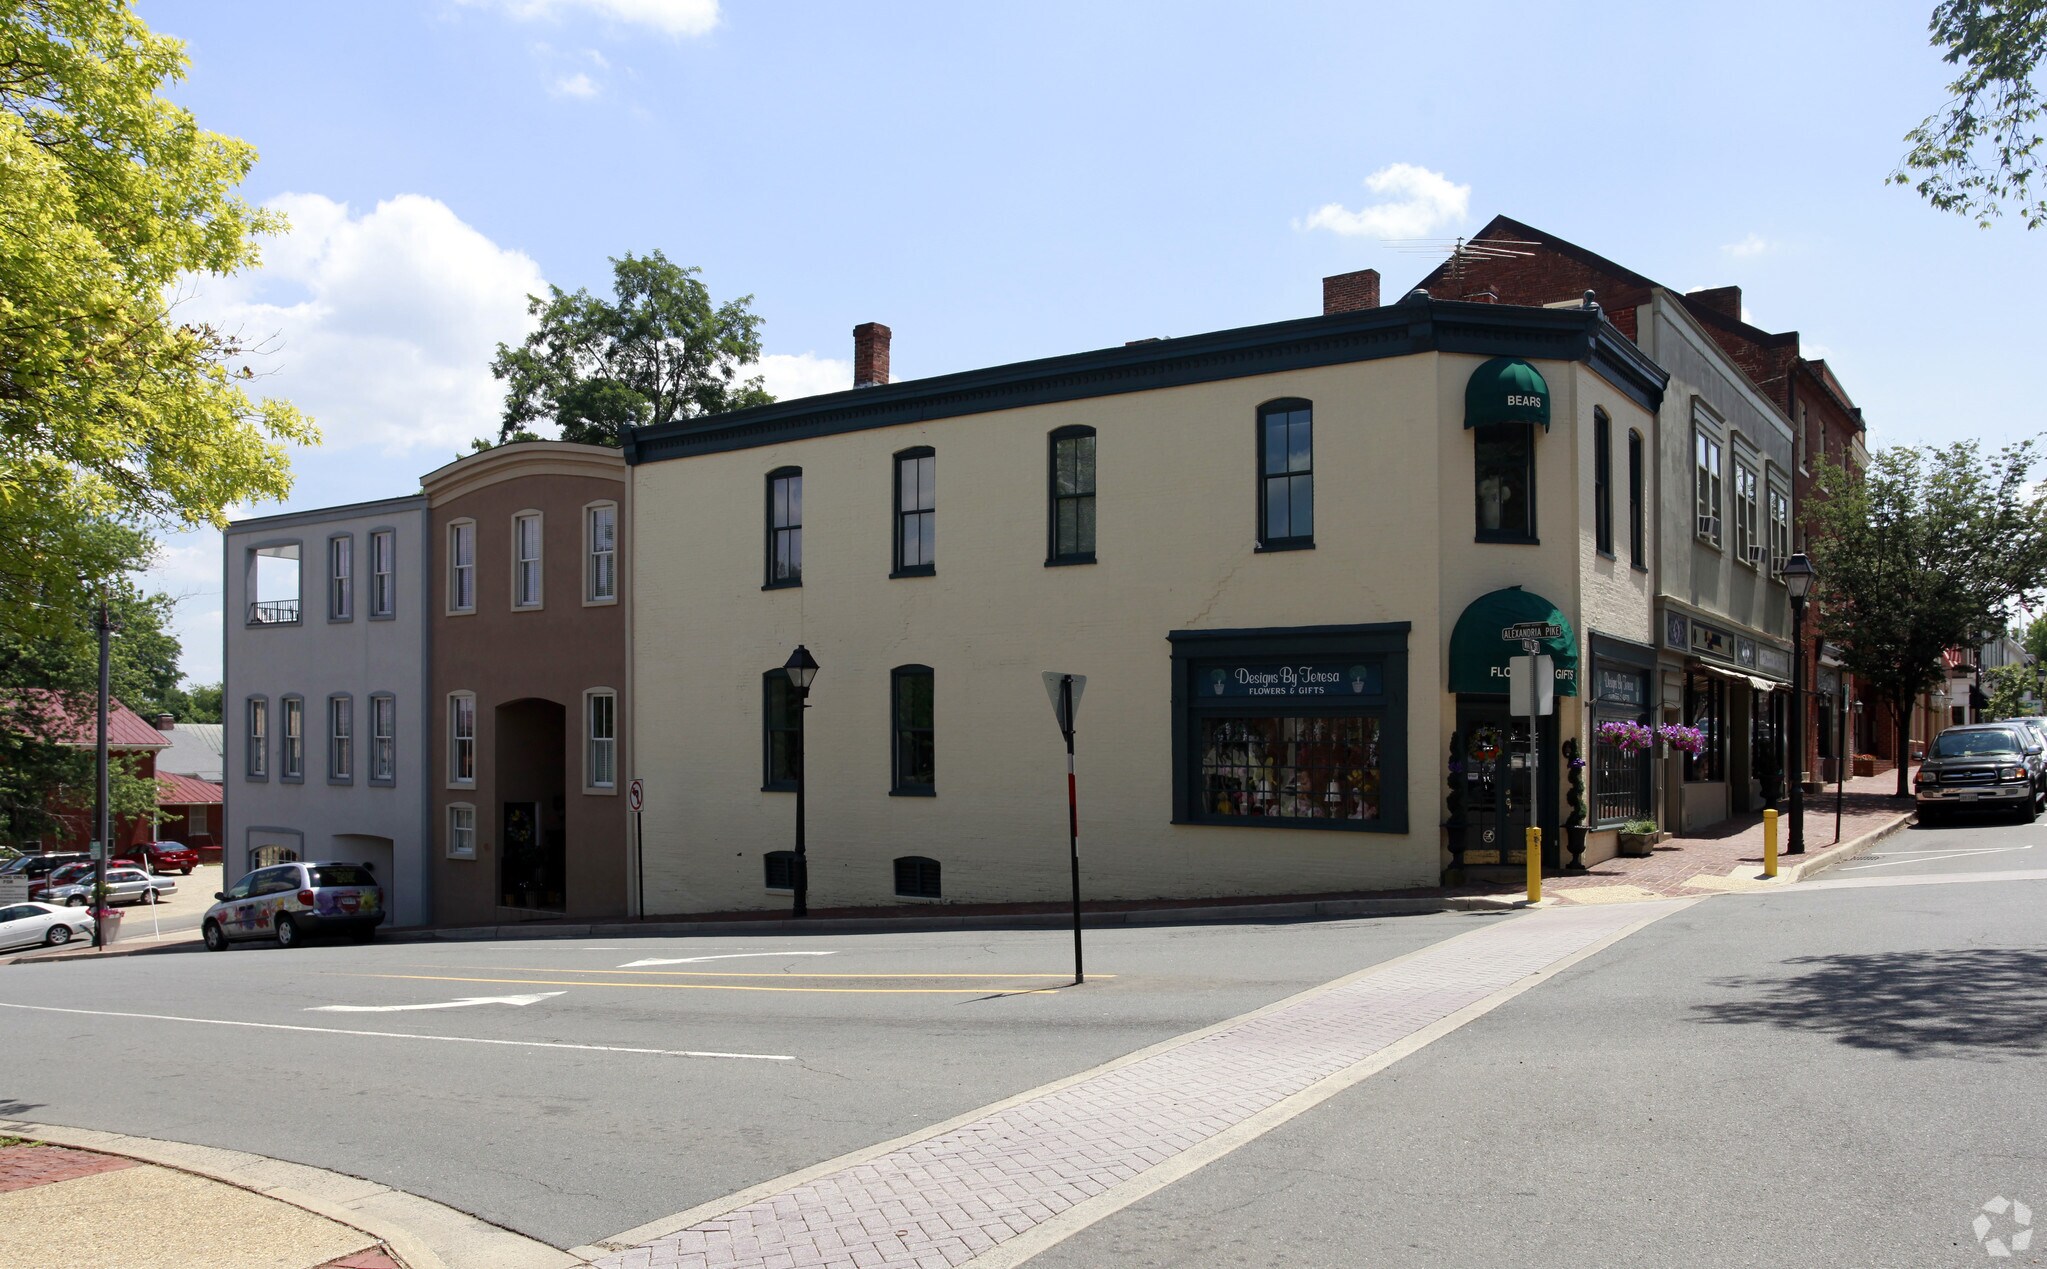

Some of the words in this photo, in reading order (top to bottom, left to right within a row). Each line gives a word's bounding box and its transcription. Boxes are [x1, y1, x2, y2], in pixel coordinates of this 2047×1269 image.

[1507, 395, 1541, 408] BEARS
[1504, 627, 1542, 639] ALEXANDRIA
[1545, 626, 1559, 636] PIKE
[1234, 667, 1278, 687] Designs
[1279, 666, 1298, 688] By
[1298, 666, 1340, 684] Teresa
[1555, 669, 1574, 680] GIFTS
[1249, 687, 1286, 695] FLOWERS
[1289, 687, 1295, 695] &
[1298, 686, 1325, 695] GIFTS
